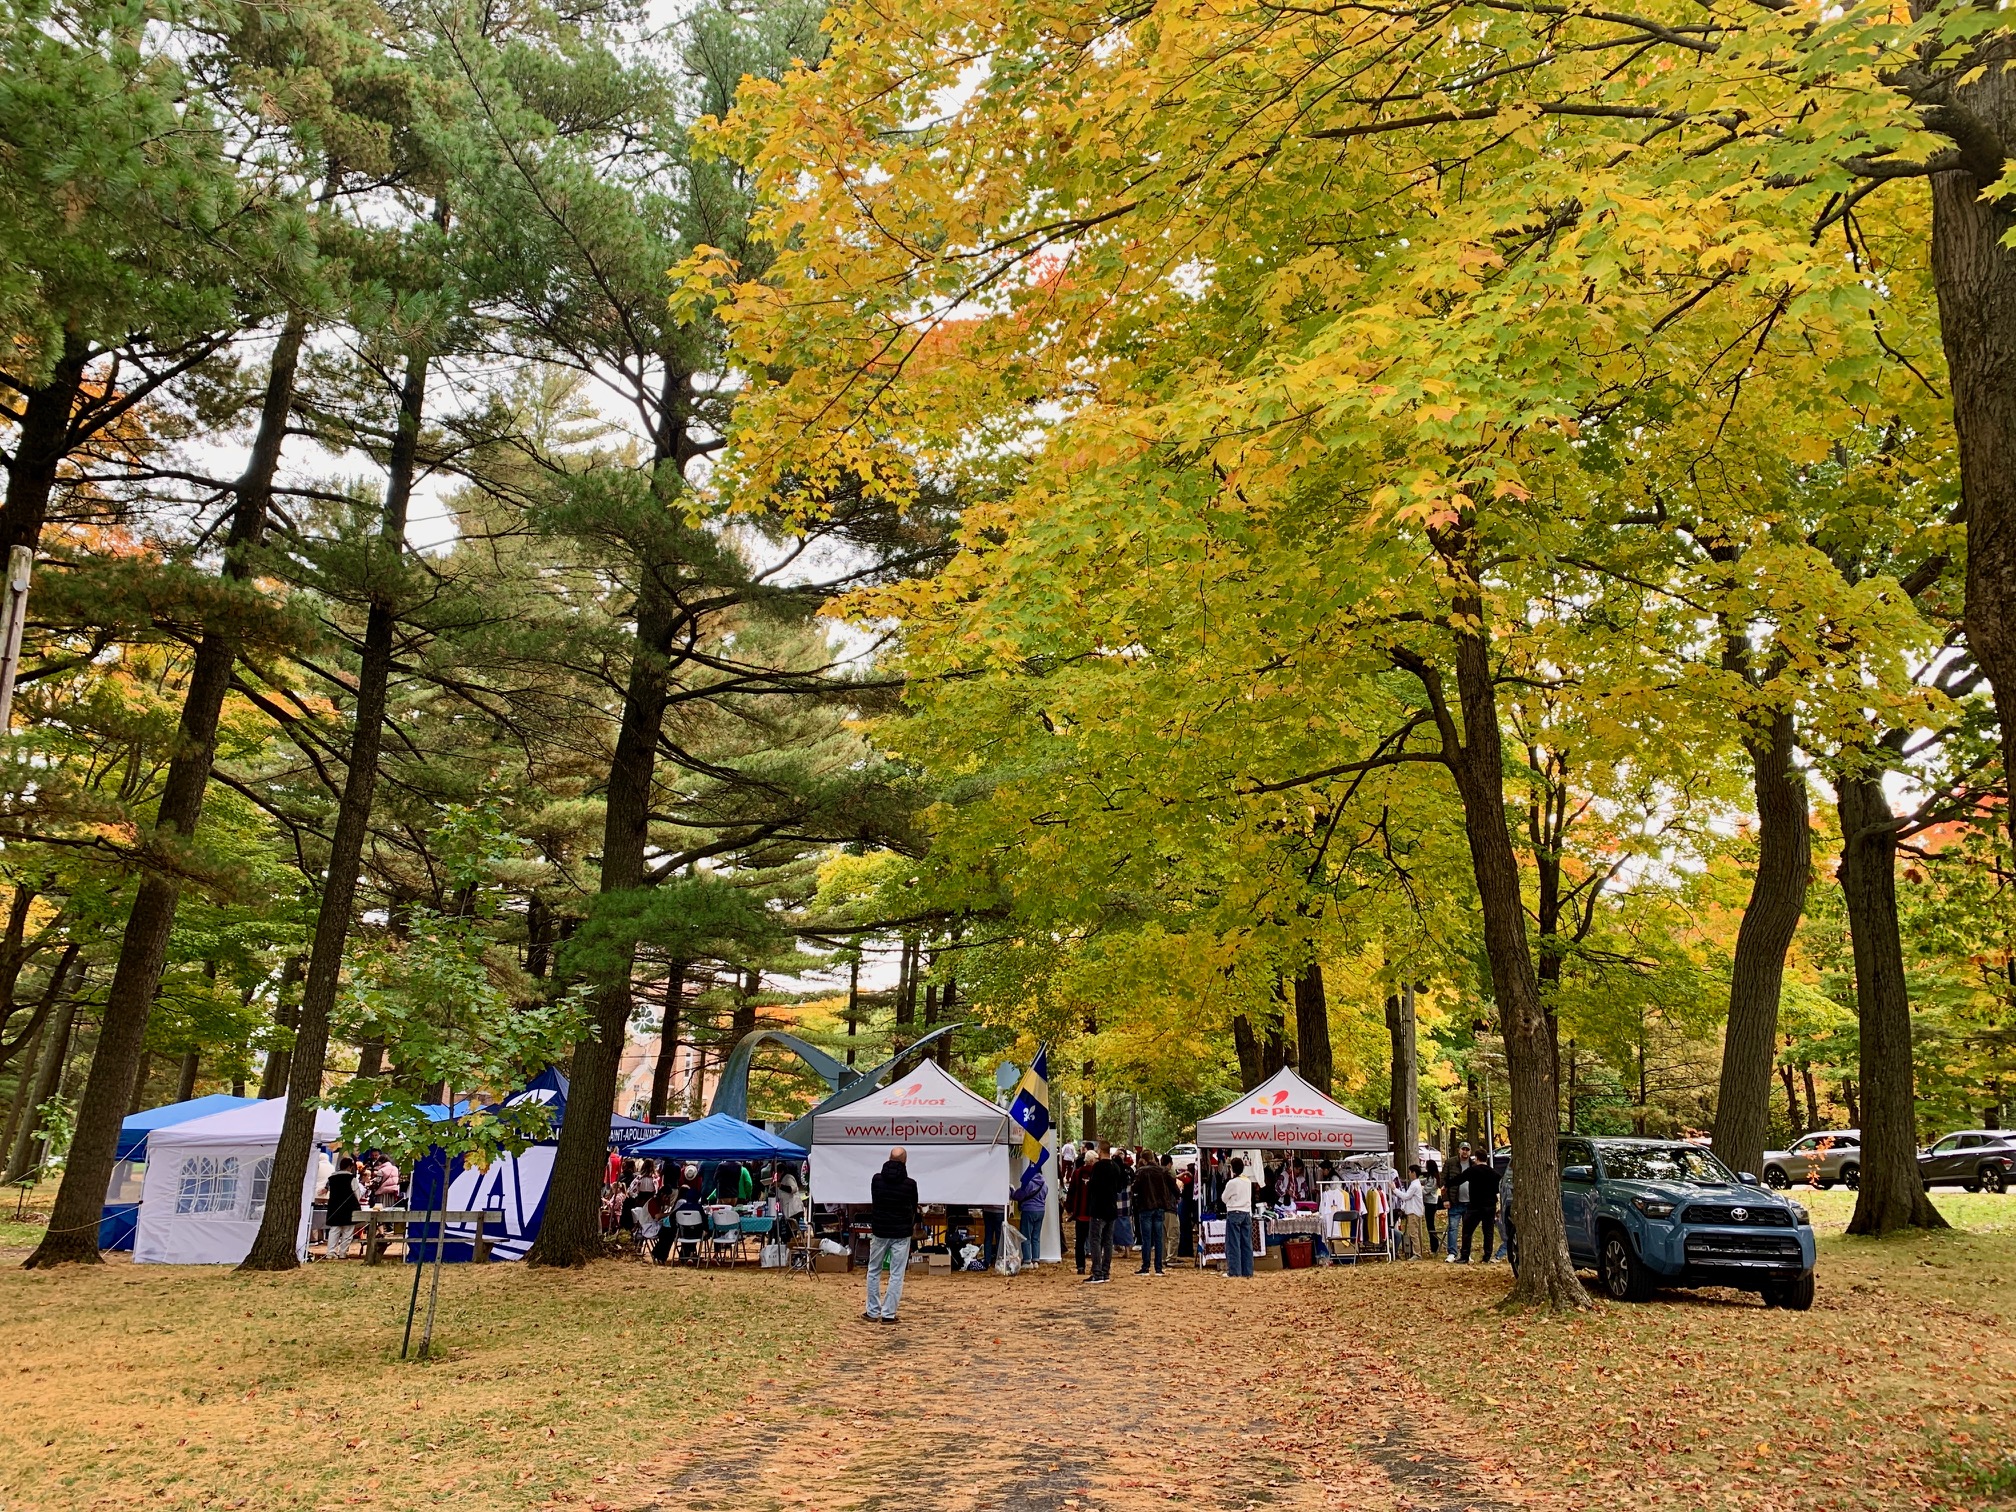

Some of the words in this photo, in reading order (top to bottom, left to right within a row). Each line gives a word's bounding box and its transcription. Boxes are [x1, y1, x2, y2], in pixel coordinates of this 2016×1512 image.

[901, 1097, 946, 1107] pivot
[1250, 1107, 1269, 1115] le
[1272, 1105, 1325, 1116] pivot
[845, 1118, 977, 1141] www.lepivot.org
[1231, 1124, 1353, 1148] www.lepivot.org
